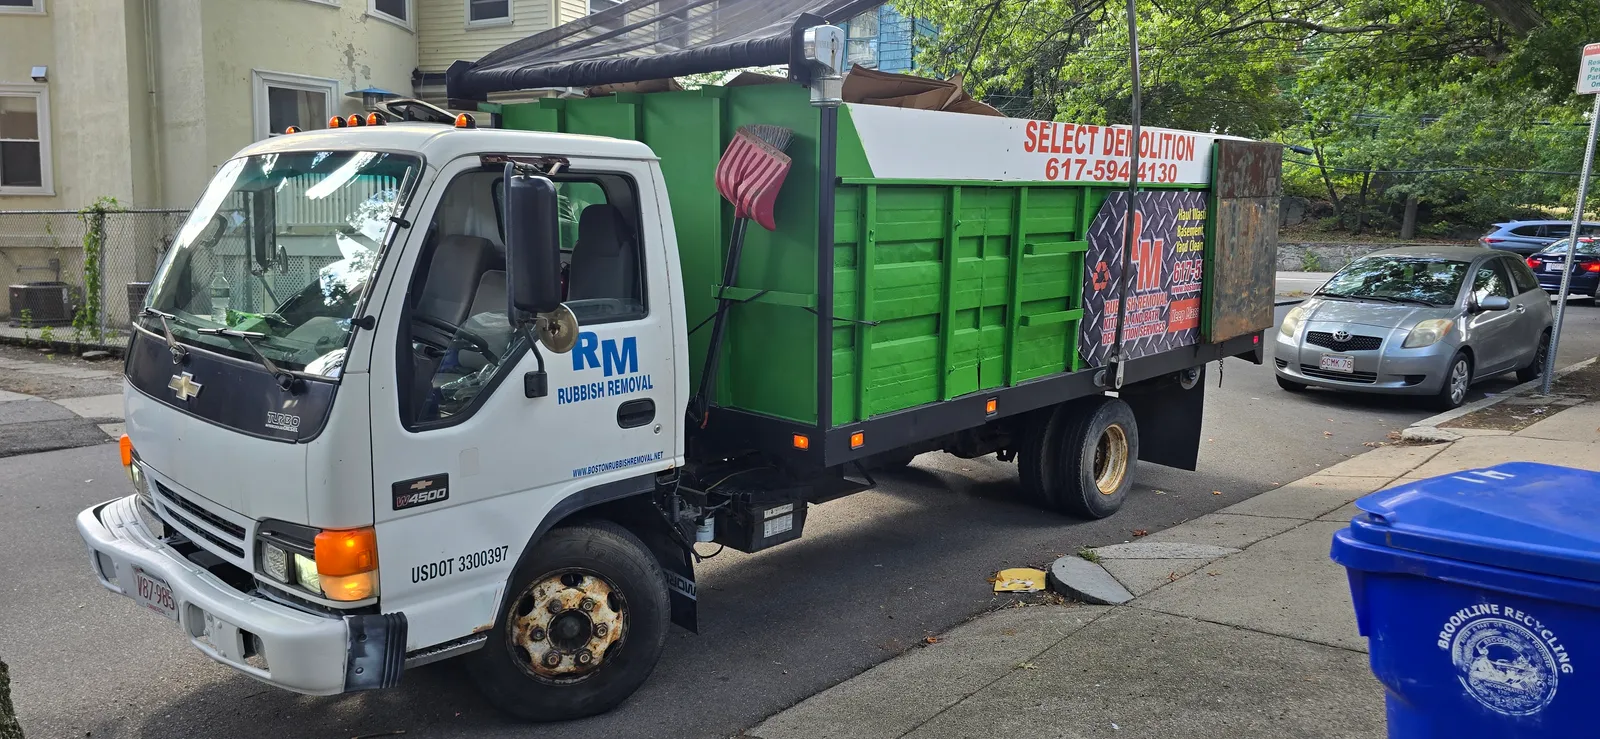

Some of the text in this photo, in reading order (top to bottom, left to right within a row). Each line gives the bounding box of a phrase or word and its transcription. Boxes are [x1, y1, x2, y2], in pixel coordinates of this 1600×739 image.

[1024, 120, 1099, 155] SELECT
[1045, 157, 1178, 184] 617-5944130
[1104, 291, 1168, 317] RUBSH REMOVAL
[1102, 320, 1167, 346] DEMITION SERVICES
[1103, 308, 1160, 331] KITCN AND BATH
[571, 331, 639, 377] RM
[1342, 359, 1352, 369] 78
[557, 374, 654, 405] RUBBISH REMOVAL
[267, 411, 300, 428] TURBO
[572, 451, 664, 478] WWW.BOSTONRUBBISHREMOVAL.NET
[396, 487, 447, 508] W4500
[411, 545, 509, 584] USDOT 3300397
[1437, 604, 1574, 674] BROOKLINE RECYCLING
